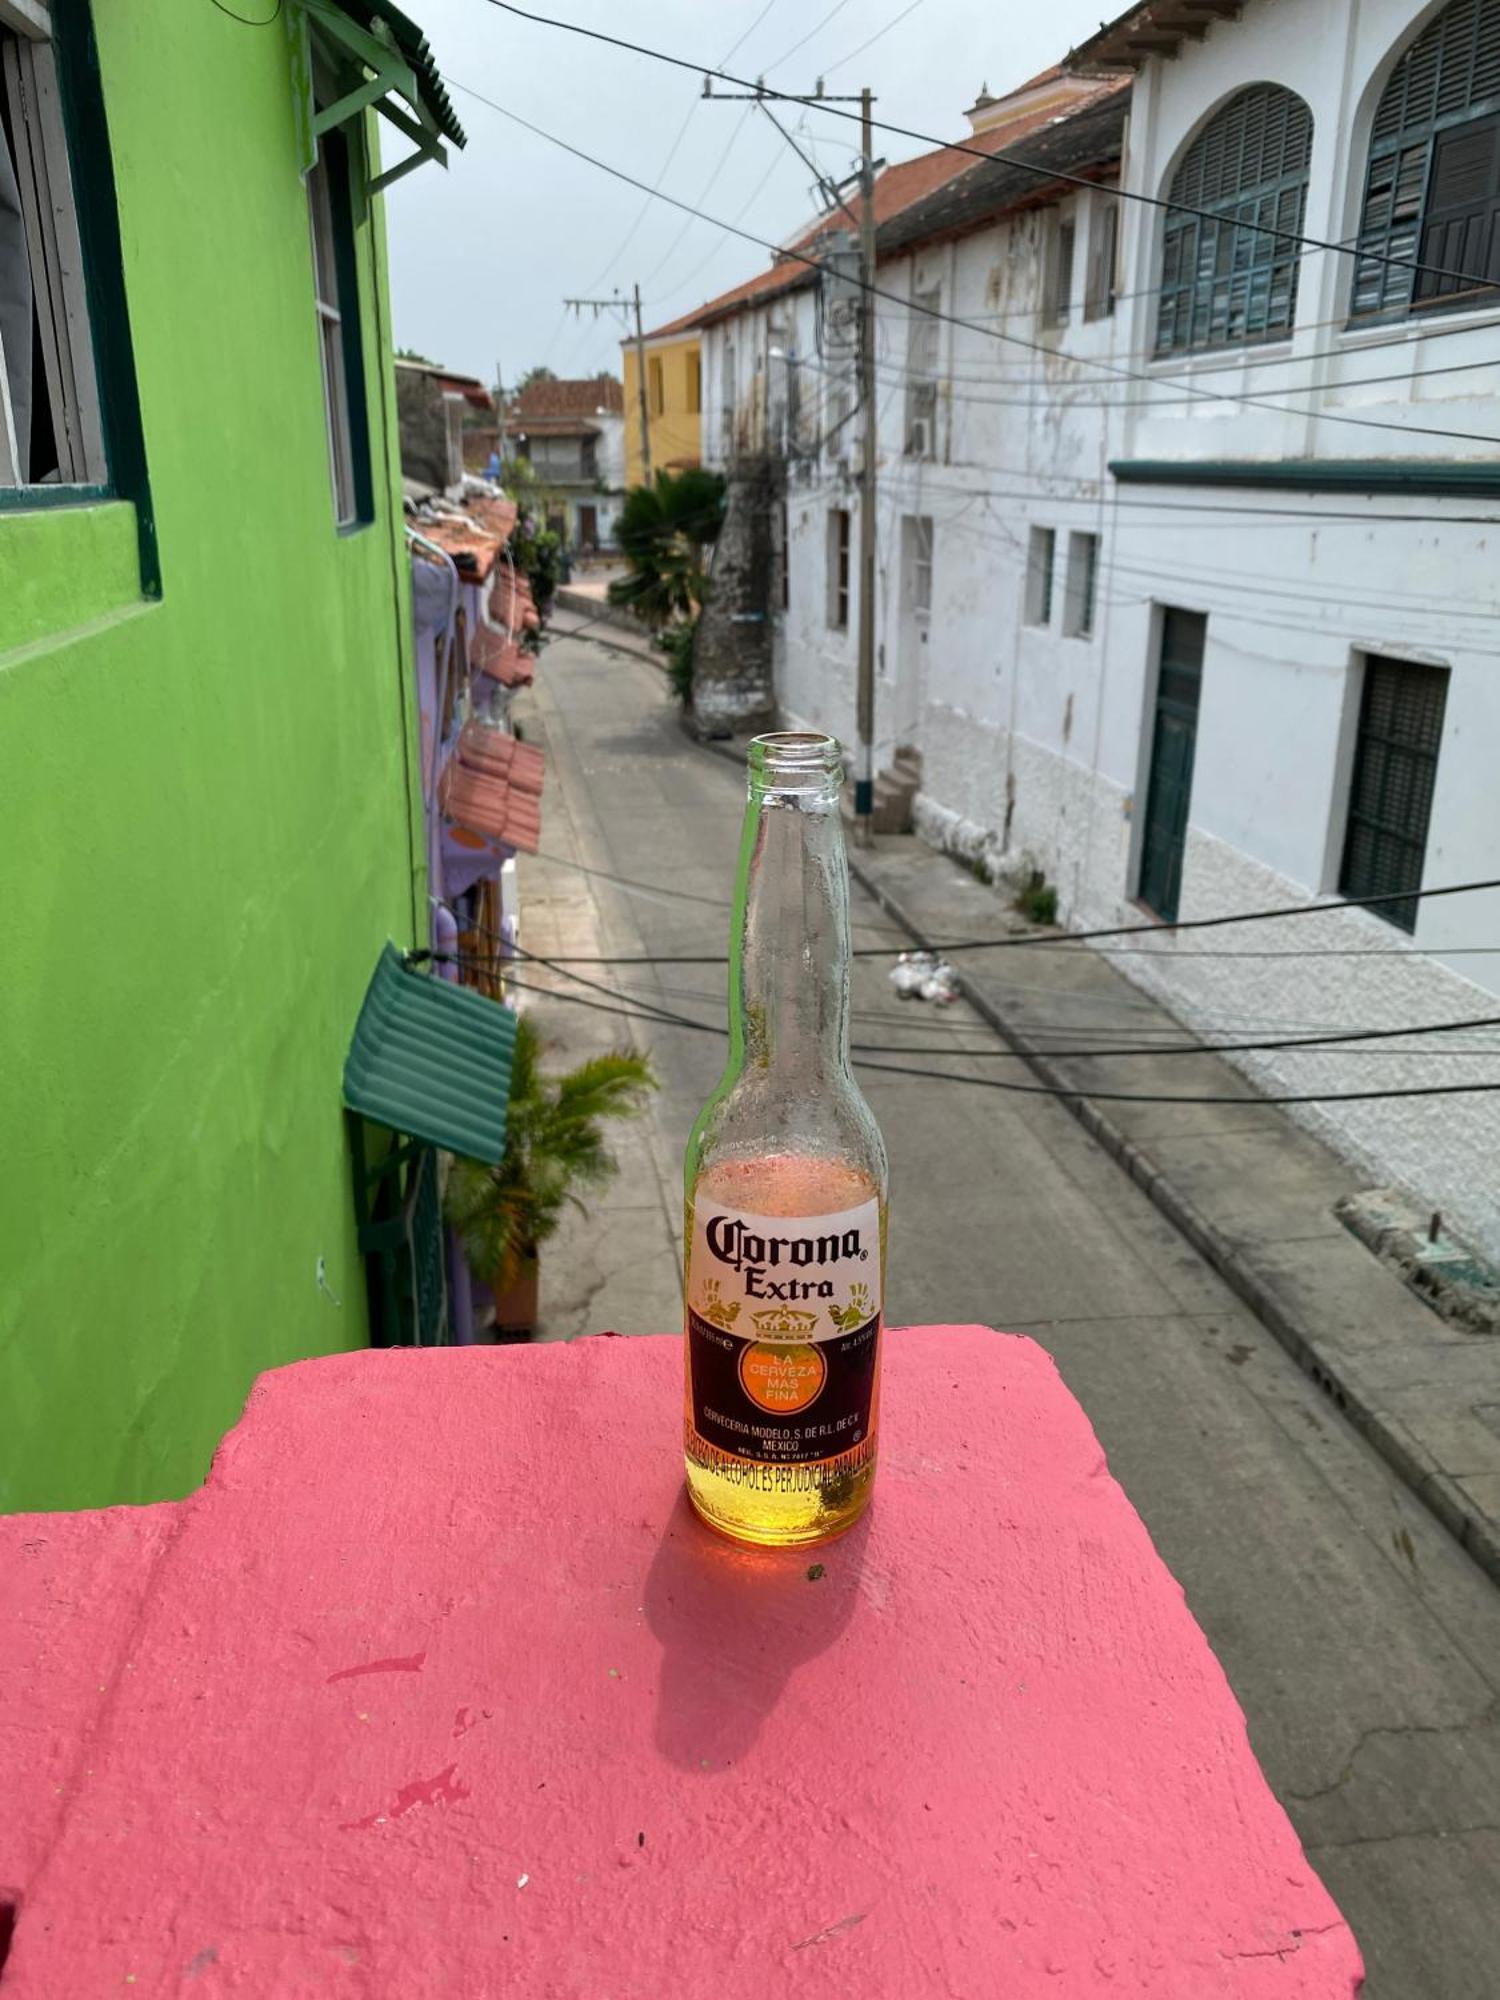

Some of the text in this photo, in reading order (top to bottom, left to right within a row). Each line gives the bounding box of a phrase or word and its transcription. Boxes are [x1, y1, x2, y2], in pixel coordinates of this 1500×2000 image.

[706, 1215, 862, 1273] Corona
[744, 1266, 834, 1301] Extra
[773, 1354, 793, 1366] LA
[750, 1363, 817, 1377] CERVEZA
[766, 1390, 799, 1401] FINA
[762, 1440, 799, 1451] MEXICO
